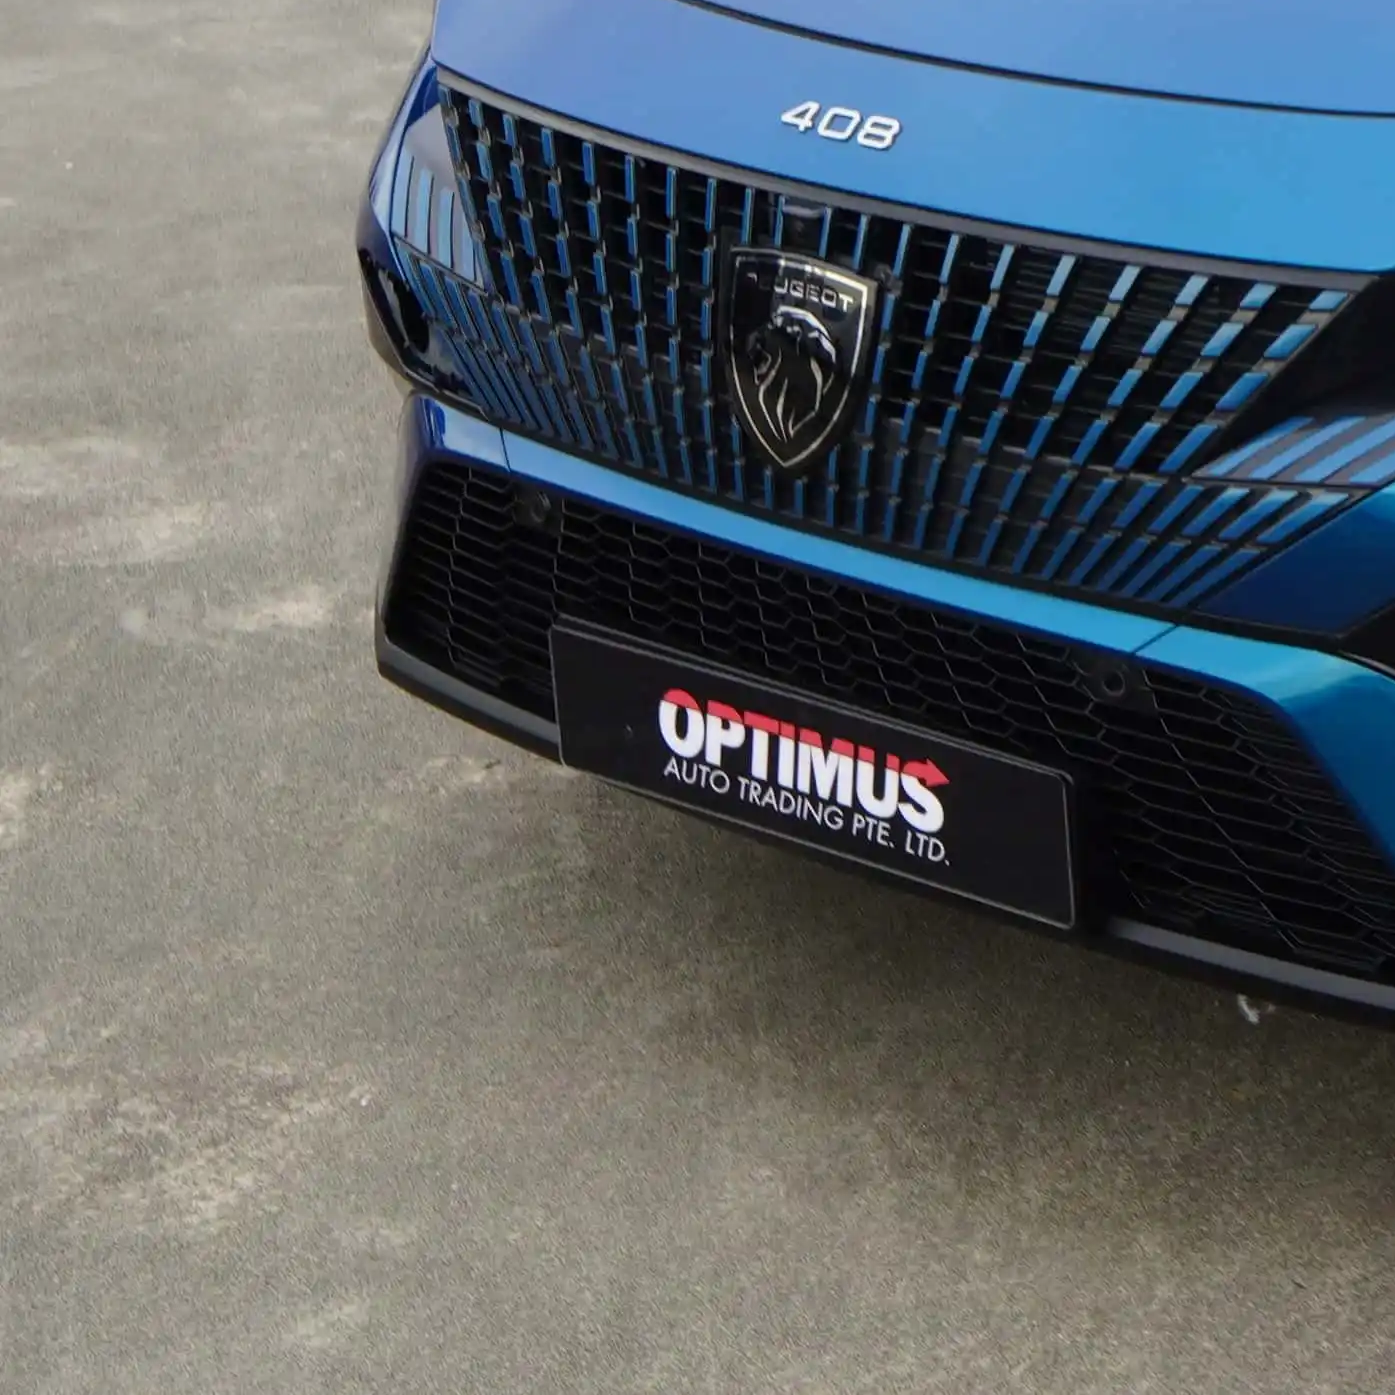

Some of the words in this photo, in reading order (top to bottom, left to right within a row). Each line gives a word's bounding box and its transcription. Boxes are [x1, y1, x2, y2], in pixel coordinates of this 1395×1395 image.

[781, 101, 901, 149] 408
[744, 271, 854, 312] UGEOT
[658, 688, 949, 833] OPTIMUS
[663, 756, 731, 795] AUTO
[737, 776, 844, 831] TRADING
[852, 815, 895, 848] PTE.
[905, 832, 950, 867] LTD.
